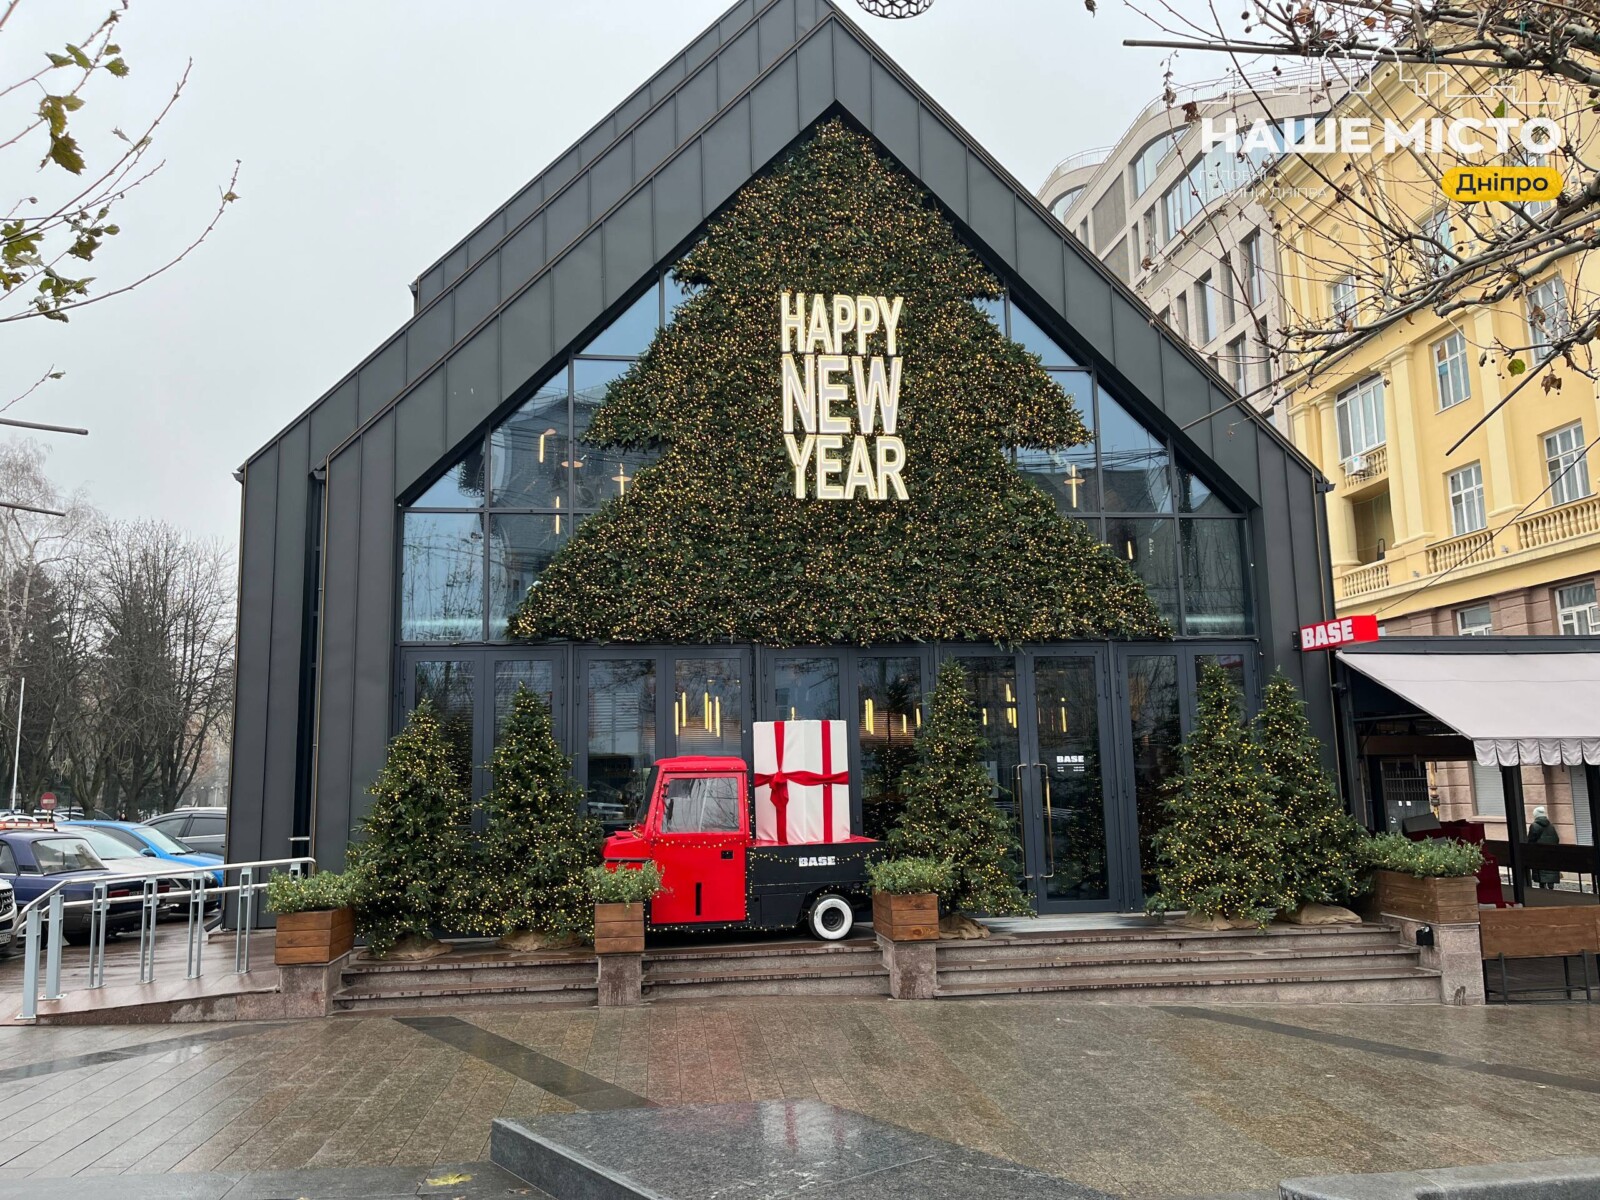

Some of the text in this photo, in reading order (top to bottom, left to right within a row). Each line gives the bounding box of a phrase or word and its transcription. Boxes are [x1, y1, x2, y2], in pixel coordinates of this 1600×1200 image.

[780, 292, 904, 356] HAPPY
[781, 354, 903, 434] NEW
[784, 434, 910, 500] YEAR
[1301, 618, 1355, 649] BASE
[1056, 755, 1085, 763] BASE
[798, 855, 836, 867] BASE
